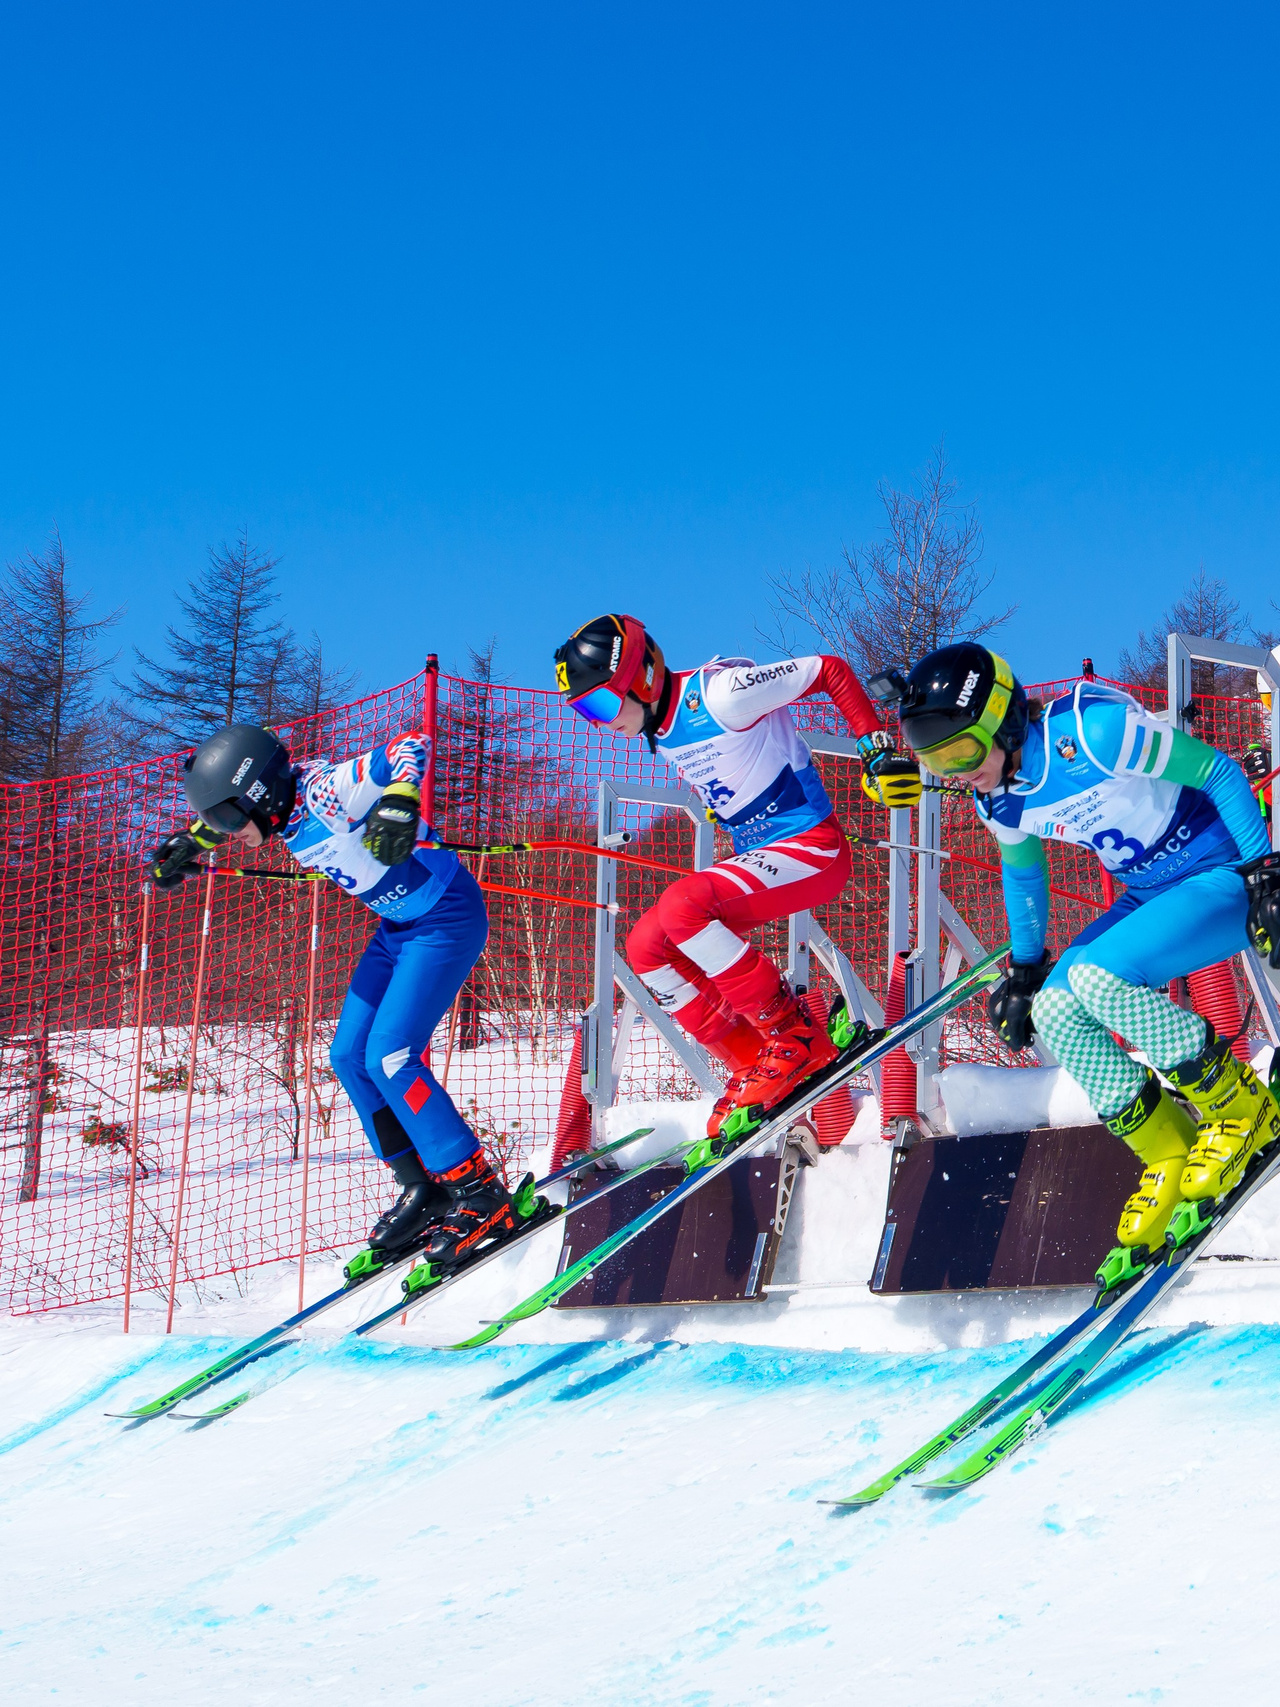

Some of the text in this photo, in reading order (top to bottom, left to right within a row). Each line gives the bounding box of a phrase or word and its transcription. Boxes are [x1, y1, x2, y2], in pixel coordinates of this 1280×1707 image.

[609, 635, 622, 673] ATOMIC
[745, 662, 799, 687] Schöffel
[956, 670, 980, 708] uvex
[232, 757, 254, 786] SHRED
[385, 807, 411, 819] LEKI
[734, 857, 779, 876] TEAM
[1106, 1097, 1145, 1134] RC4
[1220, 1096, 1273, 1186] FISCHER
[455, 1203, 510, 1256] FISCHER
